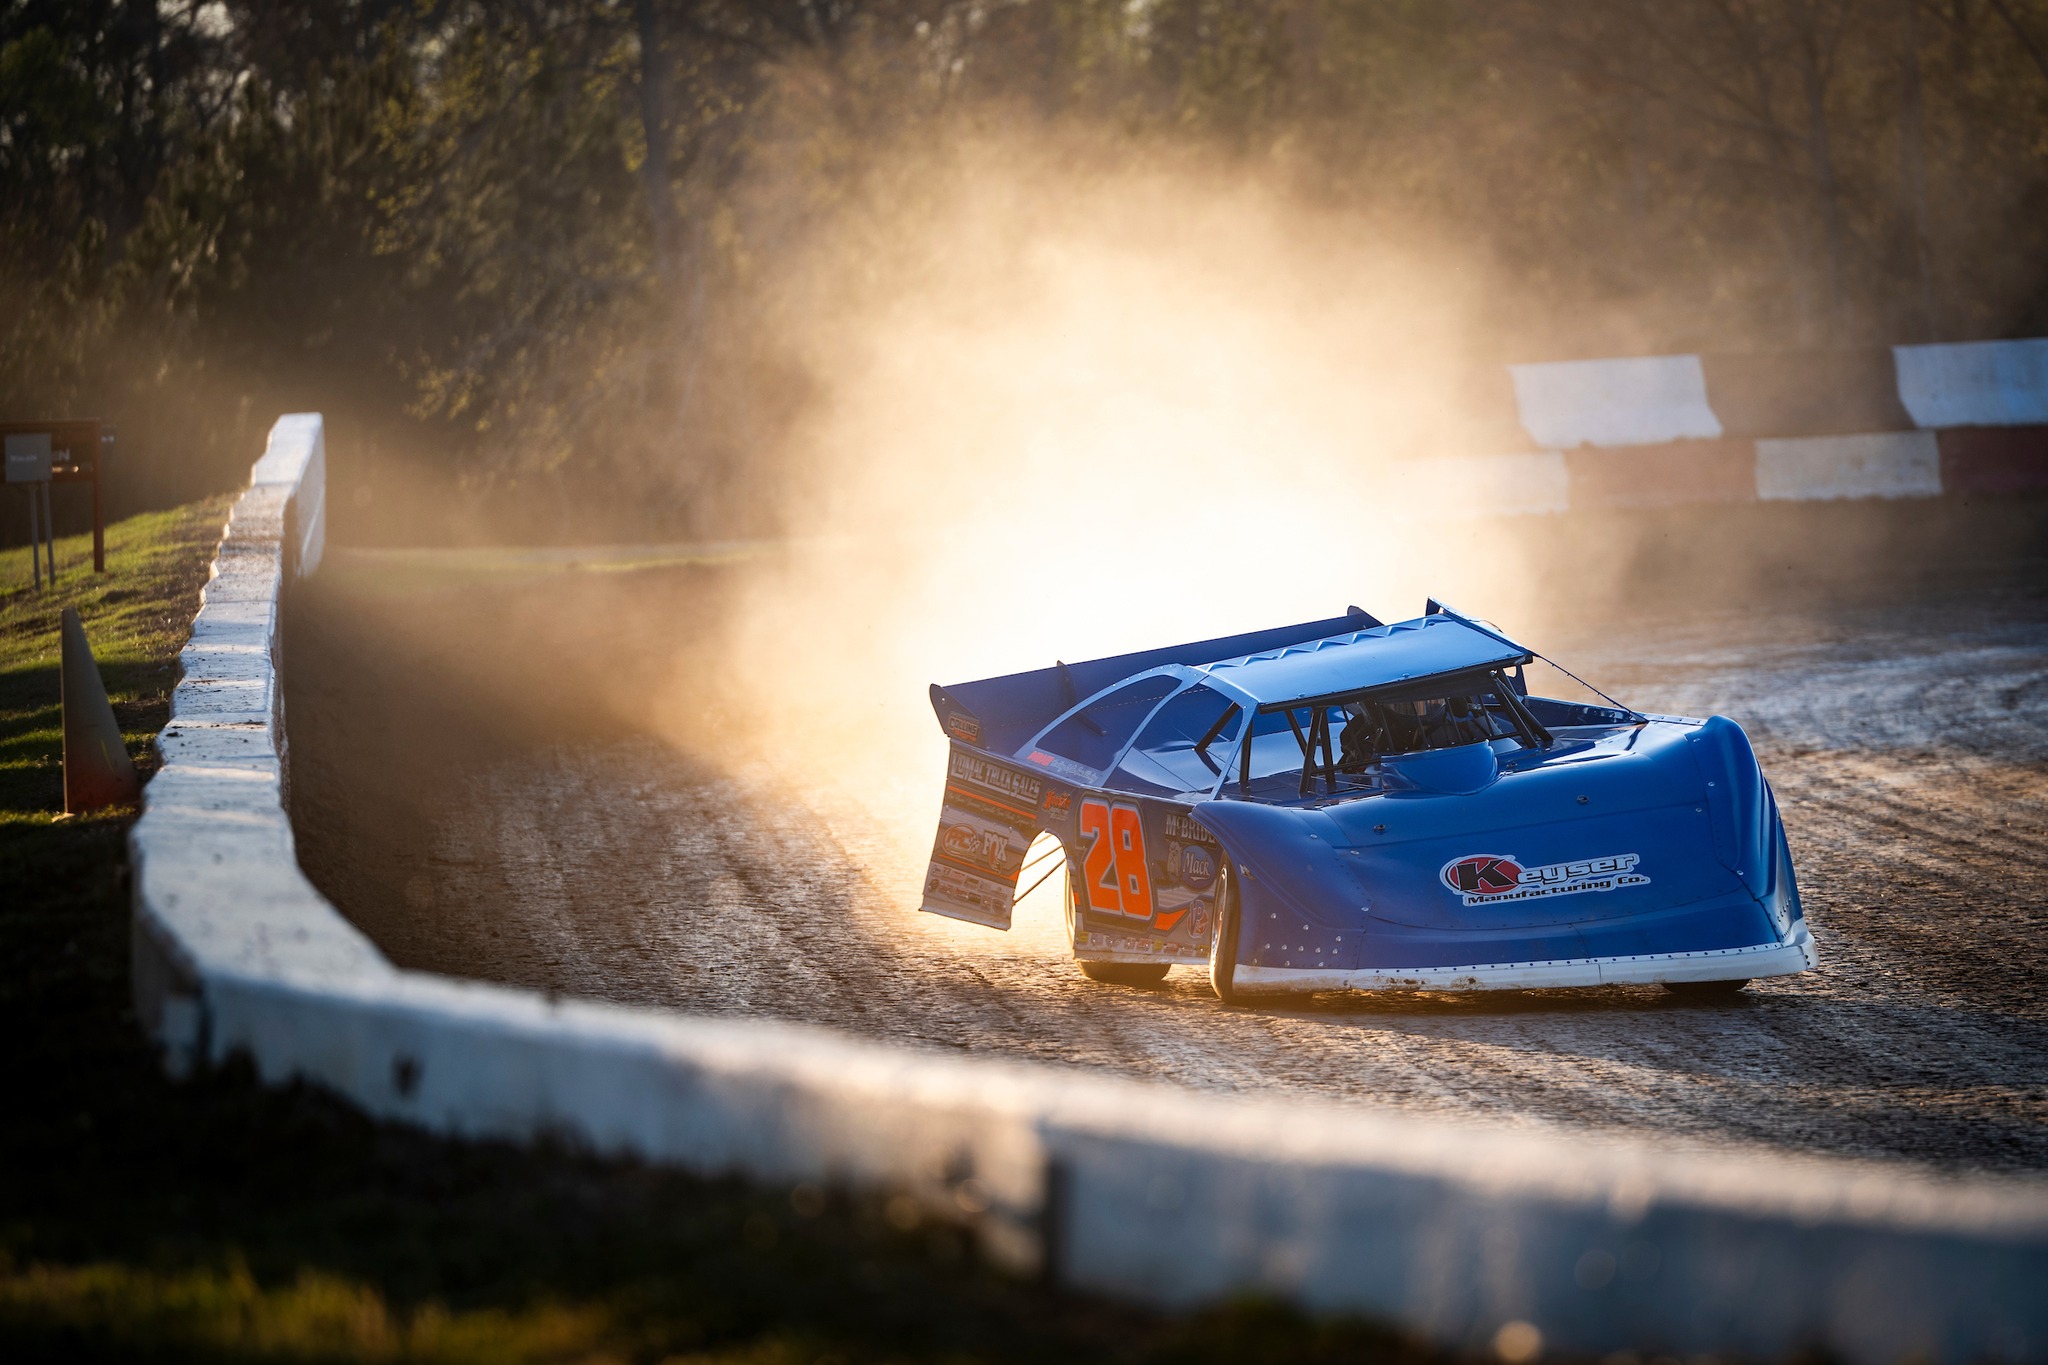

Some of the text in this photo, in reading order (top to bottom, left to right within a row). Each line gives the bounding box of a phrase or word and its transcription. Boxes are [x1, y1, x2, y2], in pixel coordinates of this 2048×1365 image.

[985, 763, 1013, 789] TRUCK
[1012, 773, 1041, 799] SALES
[982, 830, 1009, 863] FOX
[1080, 798, 1154, 921] 28
[1182, 852, 1211, 877] Mack
[1456, 855, 1636, 892] Keyser
[1468, 875, 1647, 904] Manufacturing Co.
